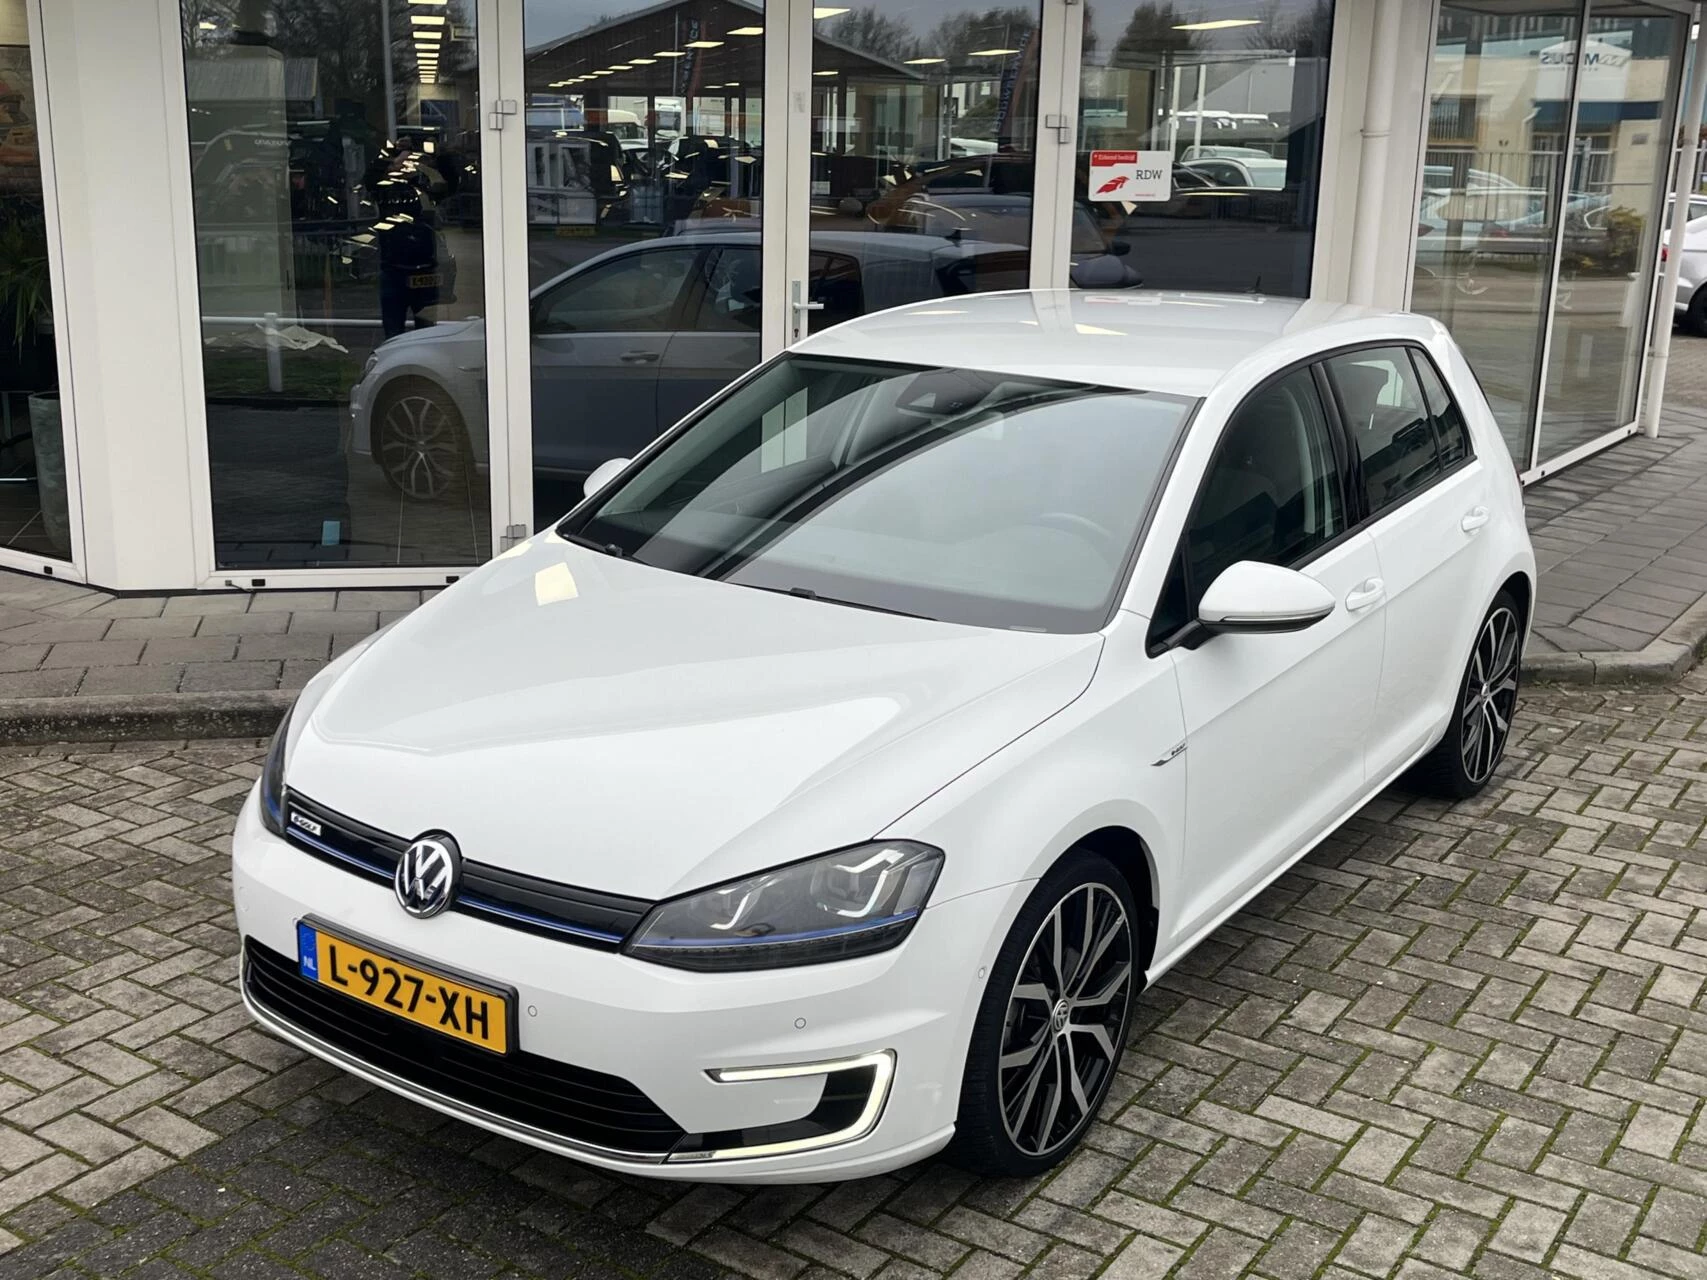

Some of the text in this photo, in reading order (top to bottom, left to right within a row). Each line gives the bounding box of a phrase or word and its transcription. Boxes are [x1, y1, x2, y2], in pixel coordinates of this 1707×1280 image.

[1136, 169, 1163, 180] RDW
[303, 954, 317, 971] NL
[329, 944, 489, 1040] L-927-XH
